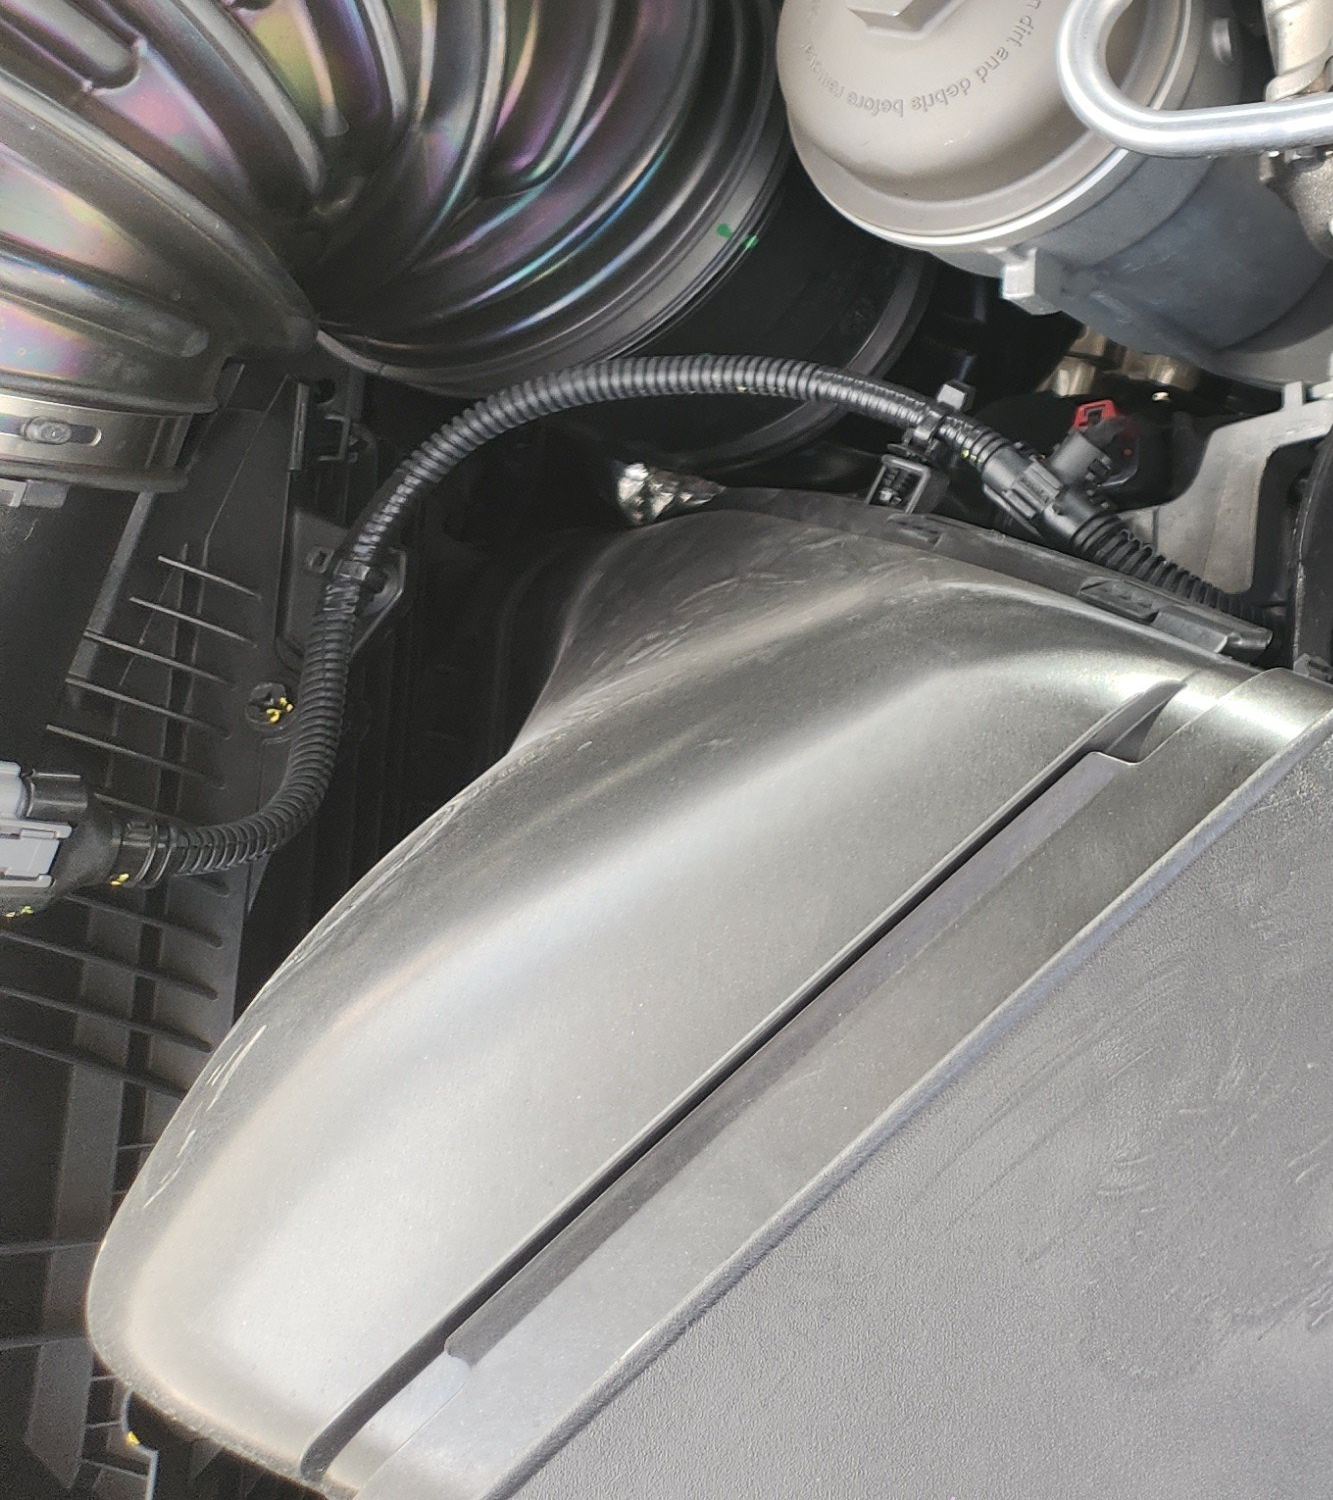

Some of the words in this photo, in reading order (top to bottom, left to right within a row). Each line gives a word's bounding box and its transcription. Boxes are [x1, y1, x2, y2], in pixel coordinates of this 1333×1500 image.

[1008, 13, 1036, 48] dirt
[975, 46, 1009, 83] and
[846, 91, 905, 118] before
[911, 77, 972, 113] debris
